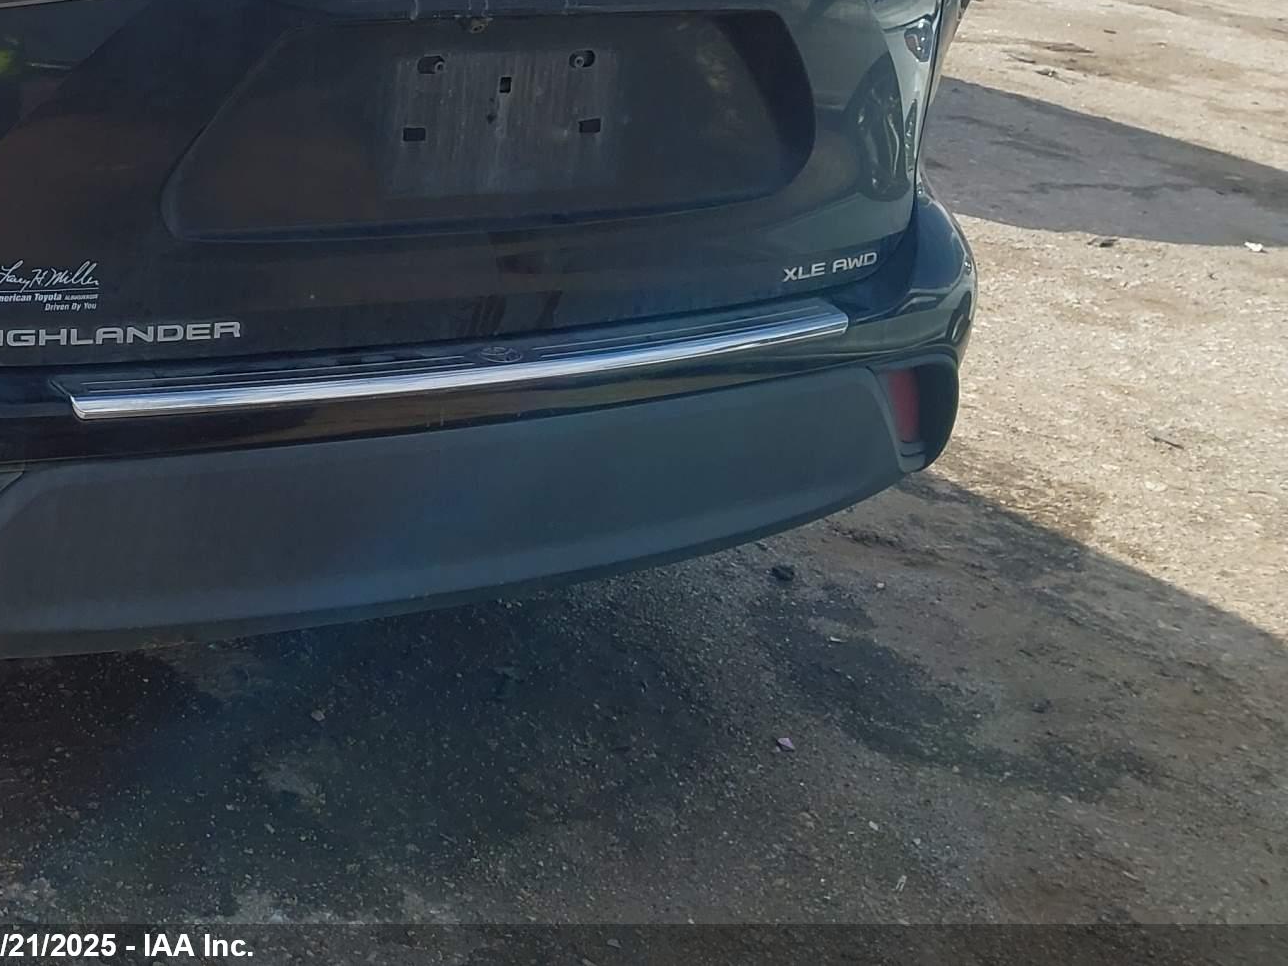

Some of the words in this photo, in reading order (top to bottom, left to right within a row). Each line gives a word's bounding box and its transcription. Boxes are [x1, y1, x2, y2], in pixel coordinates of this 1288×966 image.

[46, 260, 99, 288] Miller
[782, 262, 826, 282] XLE
[832, 252, 877, 273] AWD
[34, 293, 61, 303] Toyota
[44, 303, 69, 311] Driven
[71, 302, 81, 311] By
[83, 302, 97, 310] You
